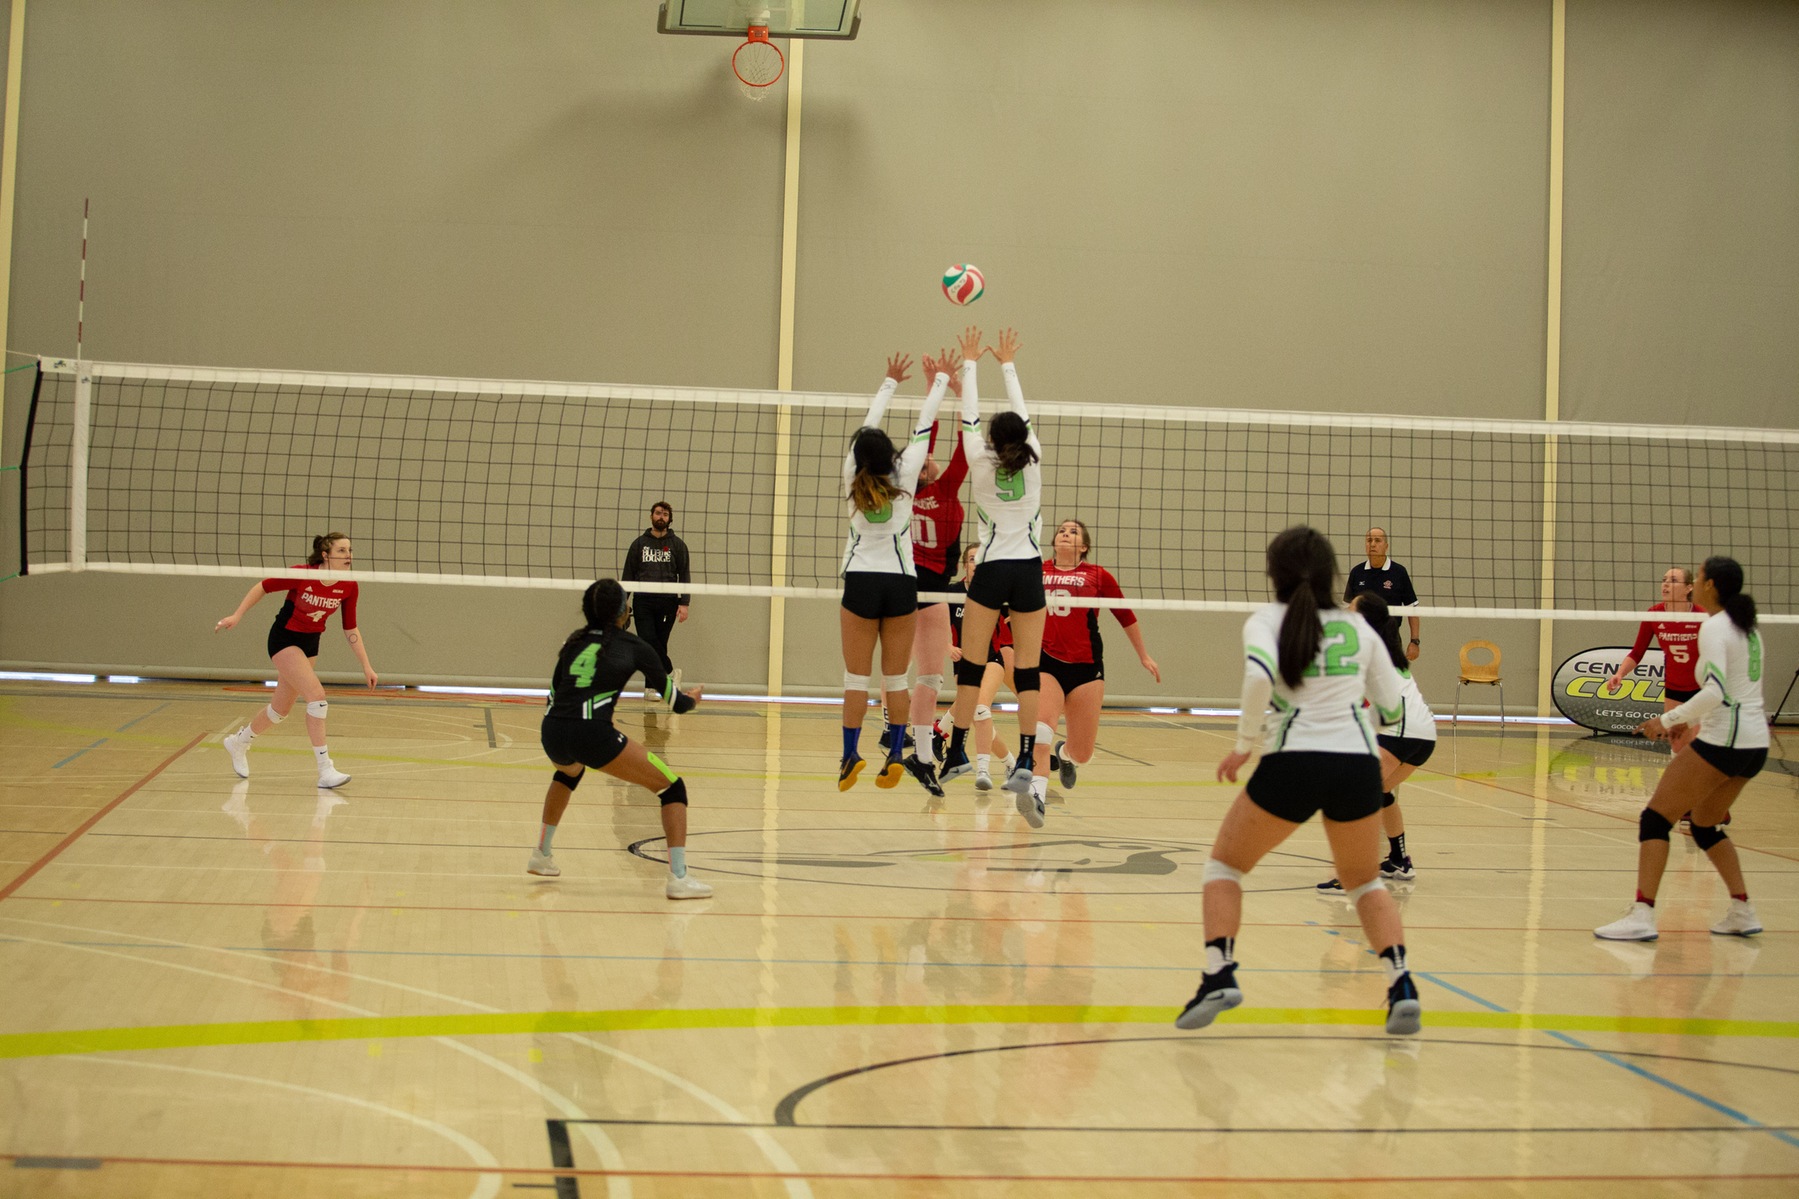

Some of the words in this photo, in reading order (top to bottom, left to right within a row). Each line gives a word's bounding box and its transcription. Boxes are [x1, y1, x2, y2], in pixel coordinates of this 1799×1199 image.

[995, 467, 1026, 502] 9
[306, 610, 327, 623] 4
[1669, 645, 1690, 663] 5
[569, 643, 602, 689] 4
[1574, 661, 1664, 678] CENEN
[1596, 709, 1623, 718] LETS
